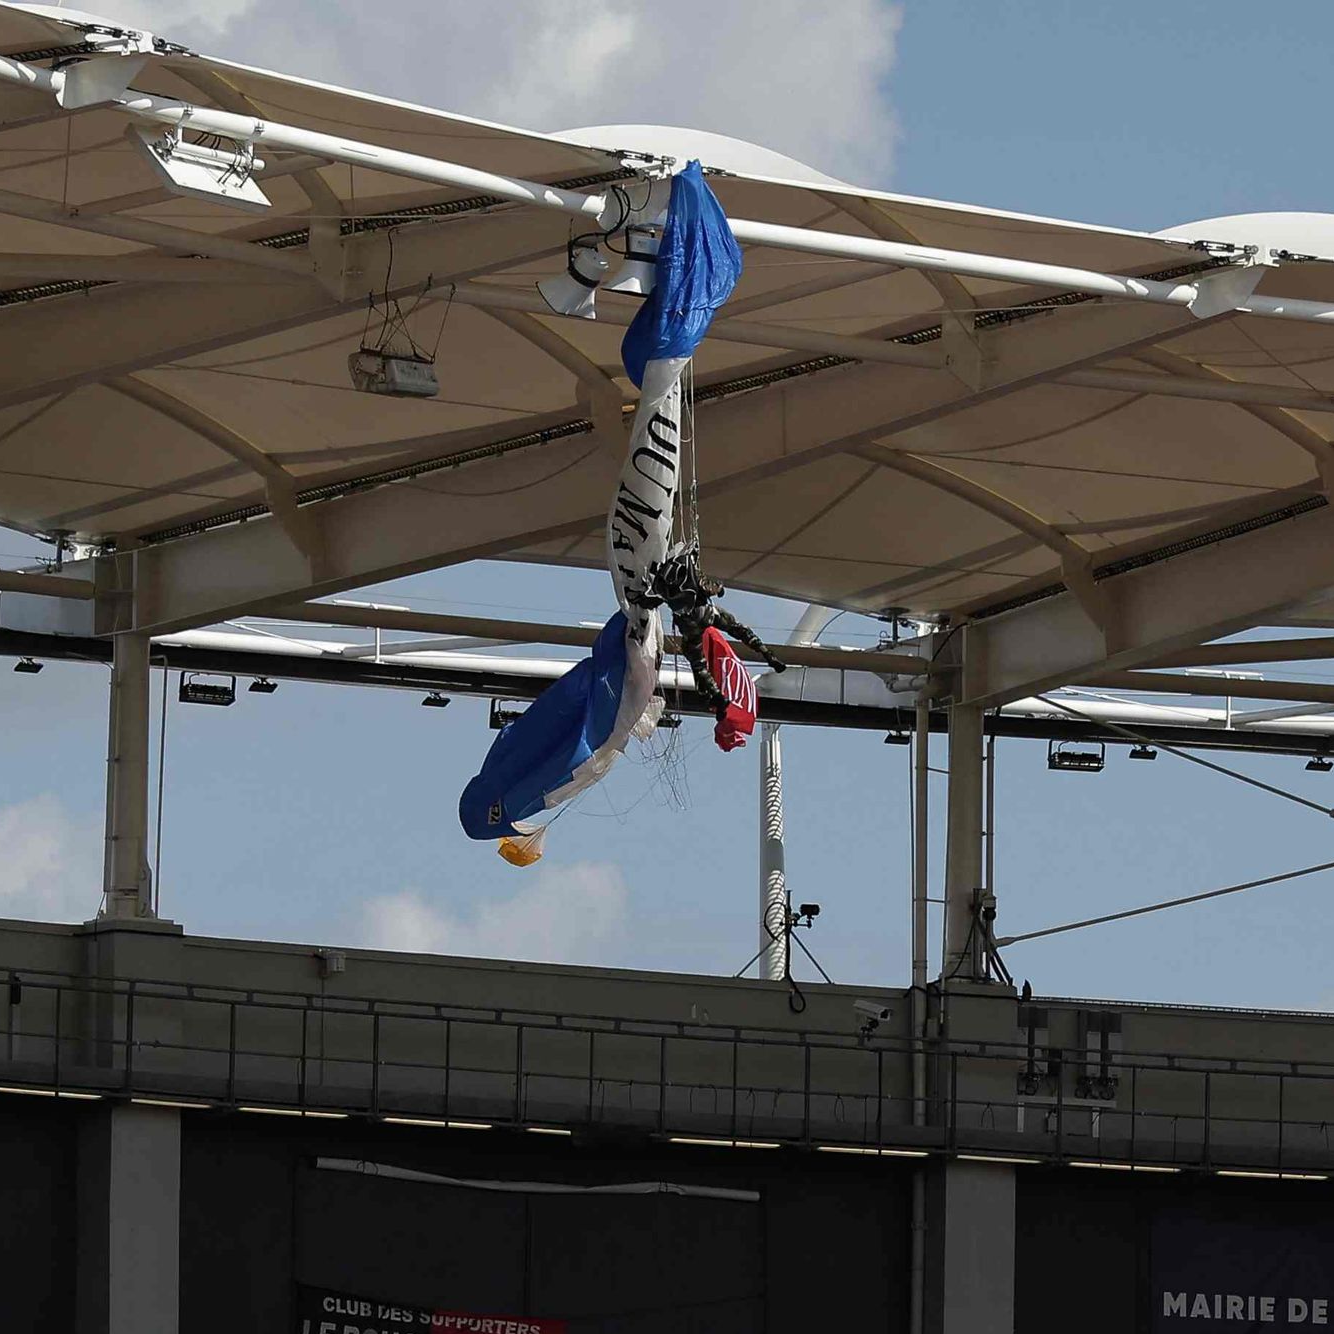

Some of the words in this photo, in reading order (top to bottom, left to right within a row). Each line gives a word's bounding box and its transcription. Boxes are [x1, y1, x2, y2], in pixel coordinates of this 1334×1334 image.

[322, 1296, 372, 1318] CLUB
[377, 1306, 415, 1324] DES
[1163, 1291, 1276, 1322] MAIRIE
[1288, 1297, 1329, 1325] DE
